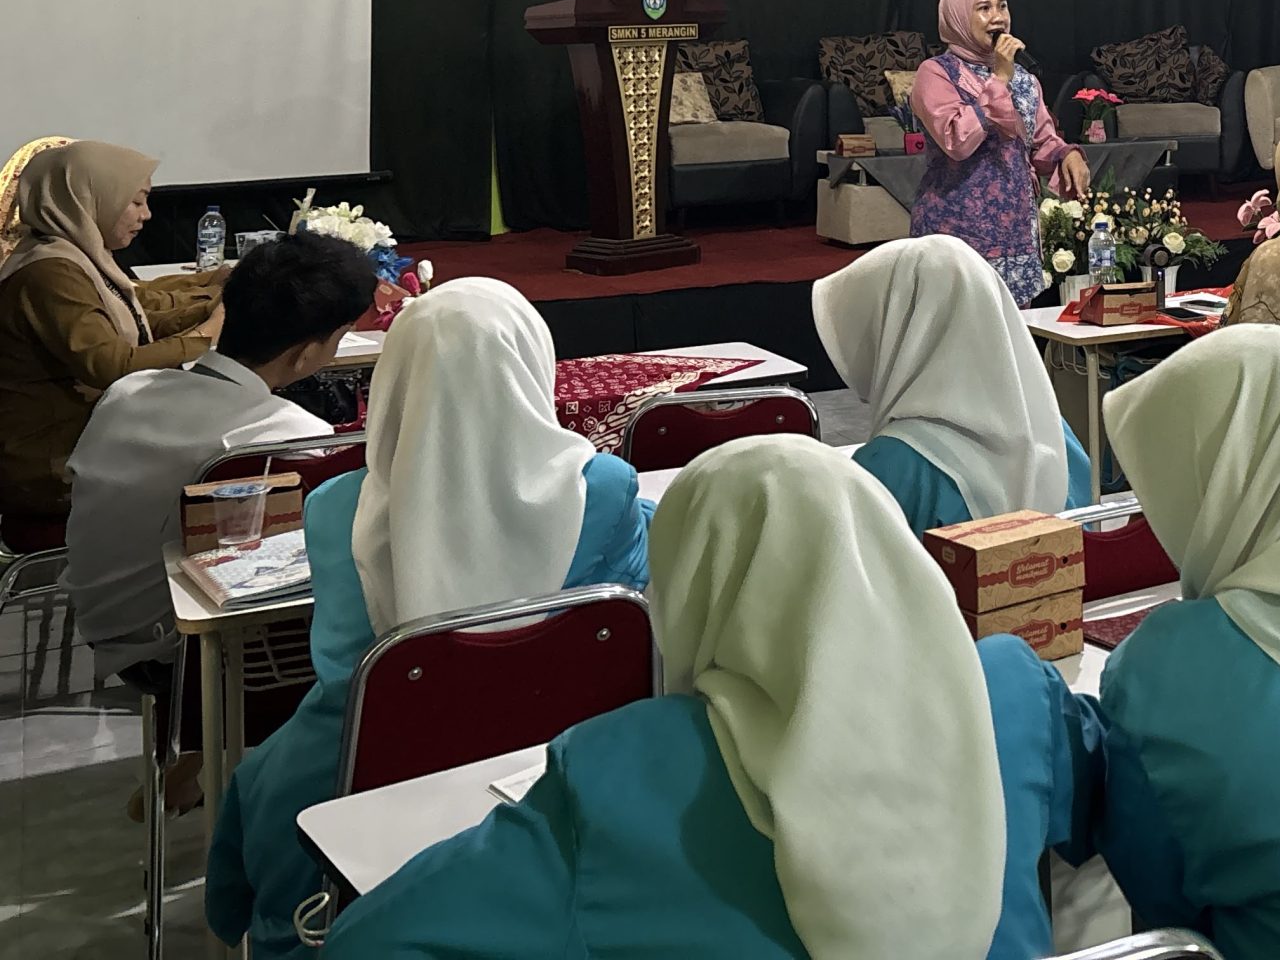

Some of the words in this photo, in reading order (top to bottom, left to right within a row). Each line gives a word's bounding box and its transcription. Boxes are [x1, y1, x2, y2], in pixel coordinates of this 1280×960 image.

[611, 28, 639, 40] SMKN
[640, 27, 647, 38] 5
[648, 26, 696, 38] MERANGIN
